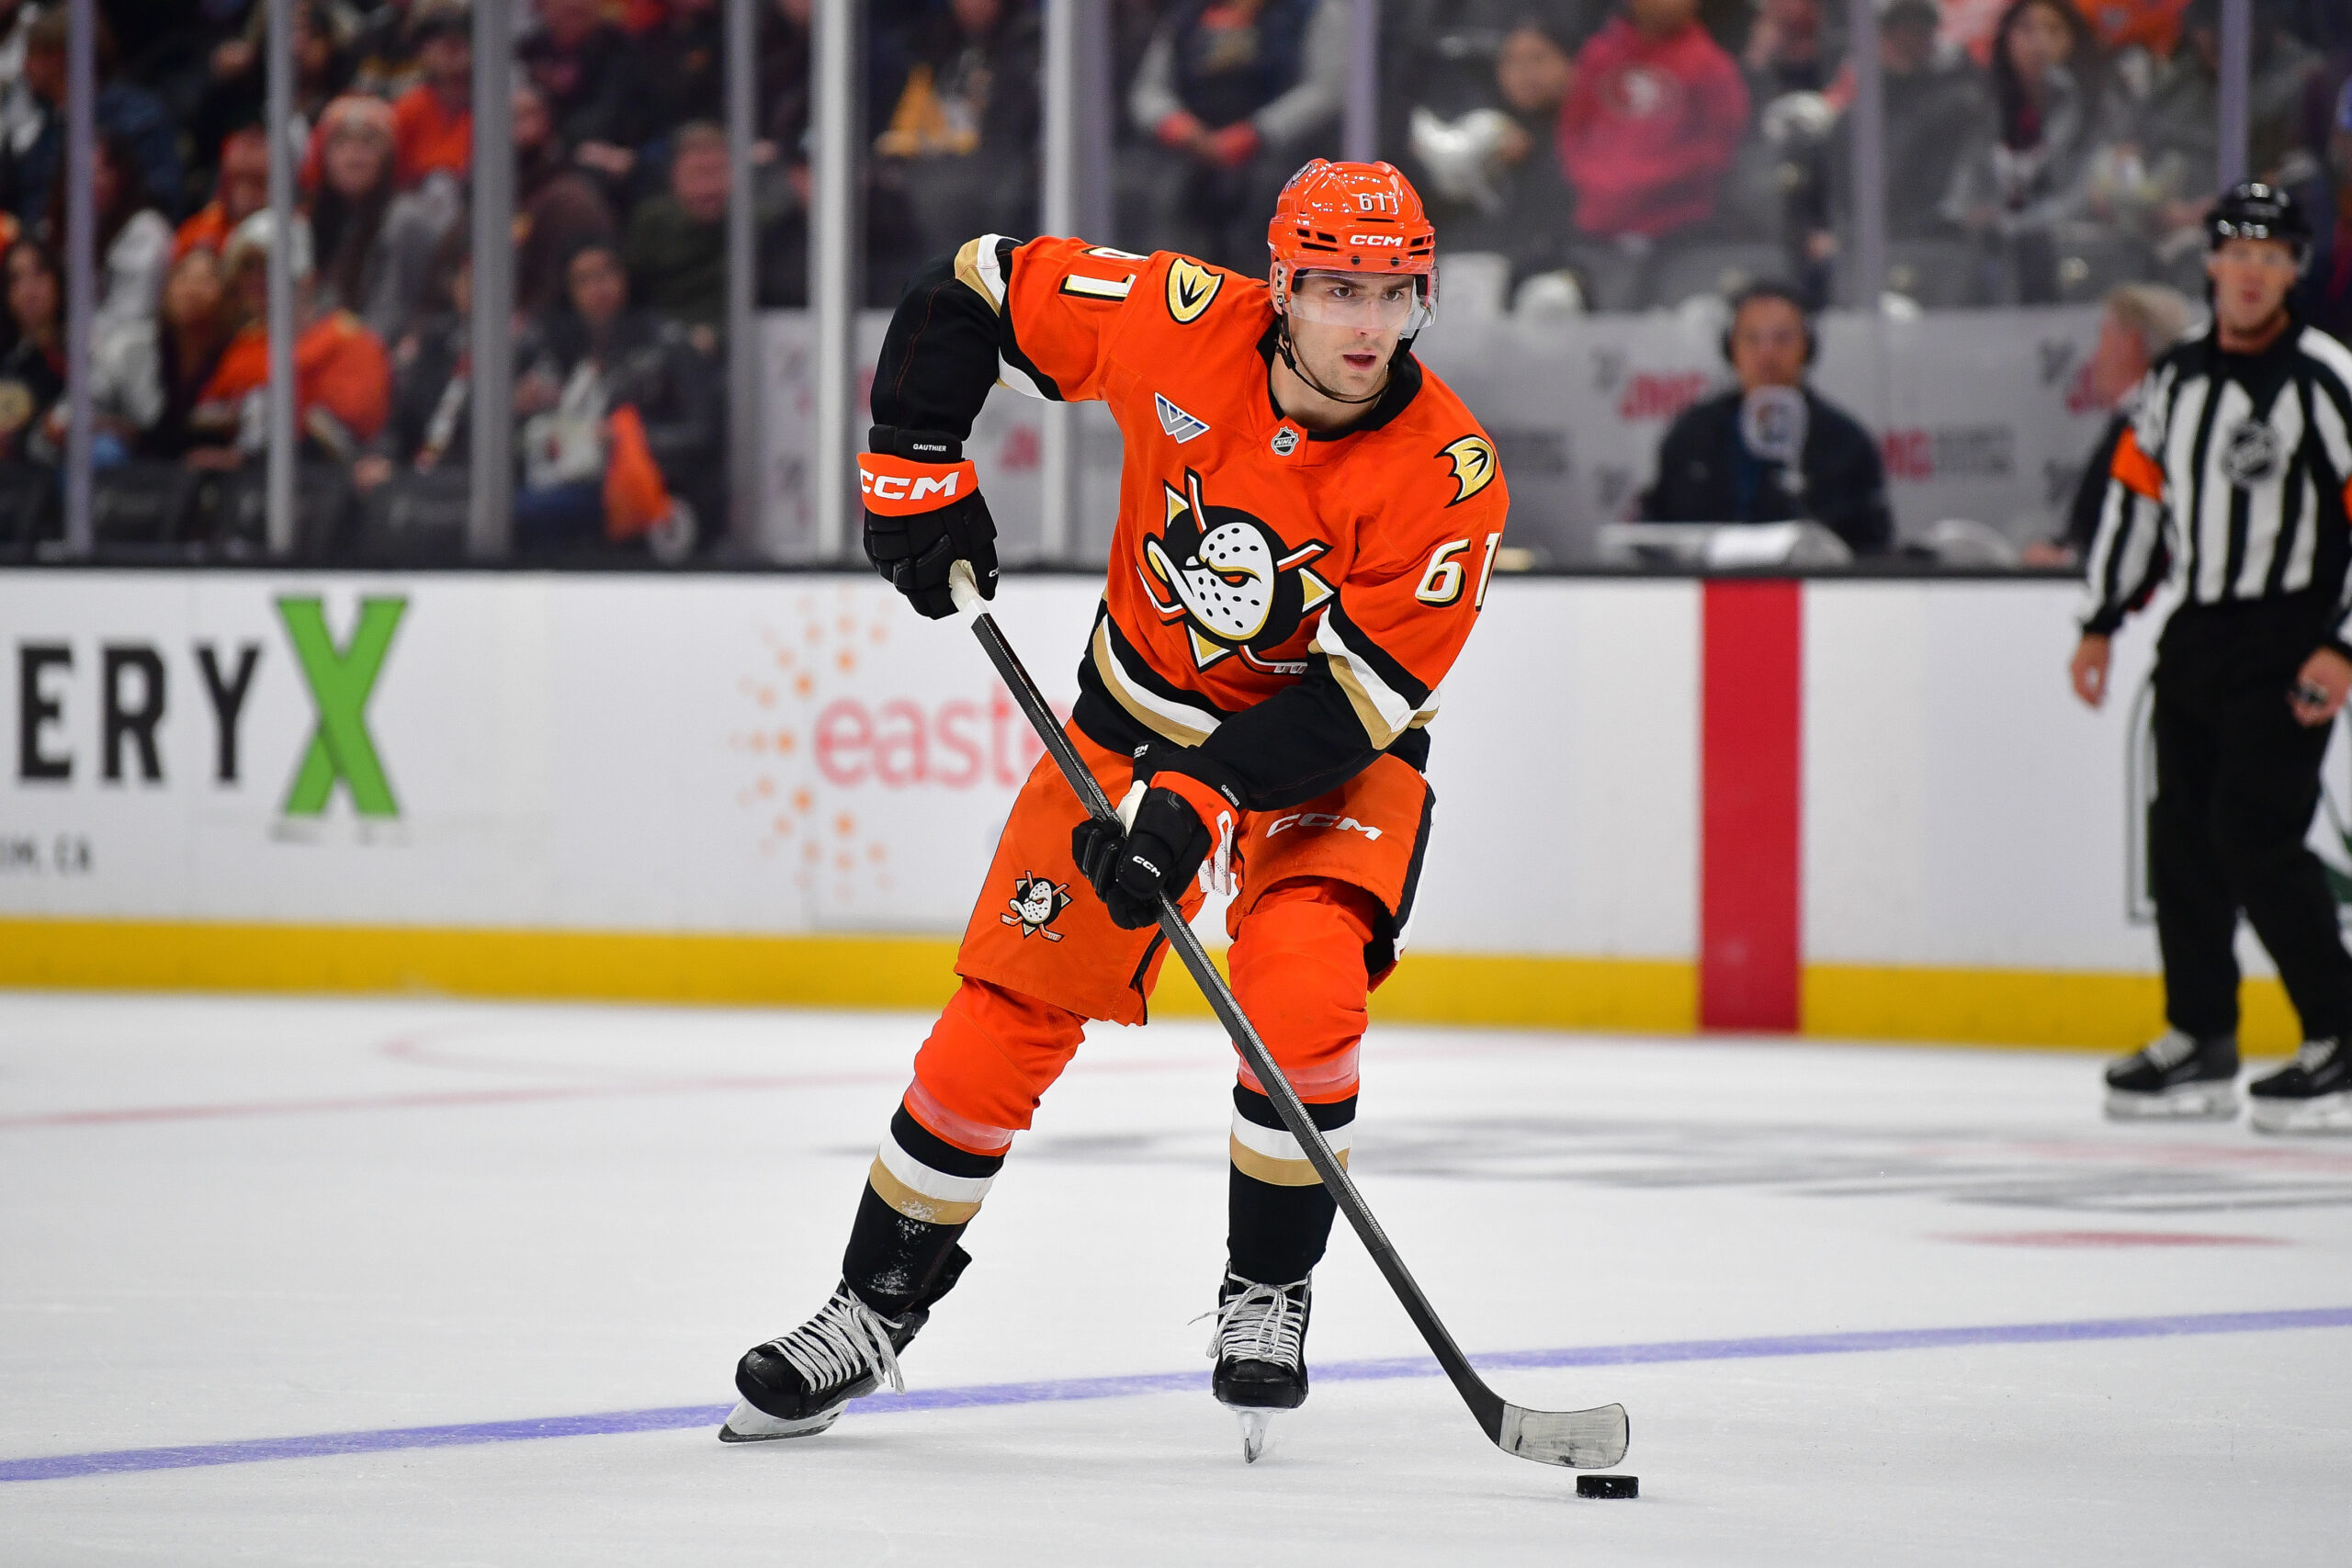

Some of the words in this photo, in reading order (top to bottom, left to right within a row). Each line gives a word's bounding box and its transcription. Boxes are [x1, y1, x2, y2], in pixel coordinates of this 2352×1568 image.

[1359, 193, 1386, 212] 61
[1350, 234, 1404, 247] CCM
[912, 443, 947, 452] GAUTHIER
[860, 468, 960, 501] CCM
[1415, 533, 1501, 612] 61
[1266, 813, 1384, 841] CCM
[1132, 855, 1161, 878] CCM
